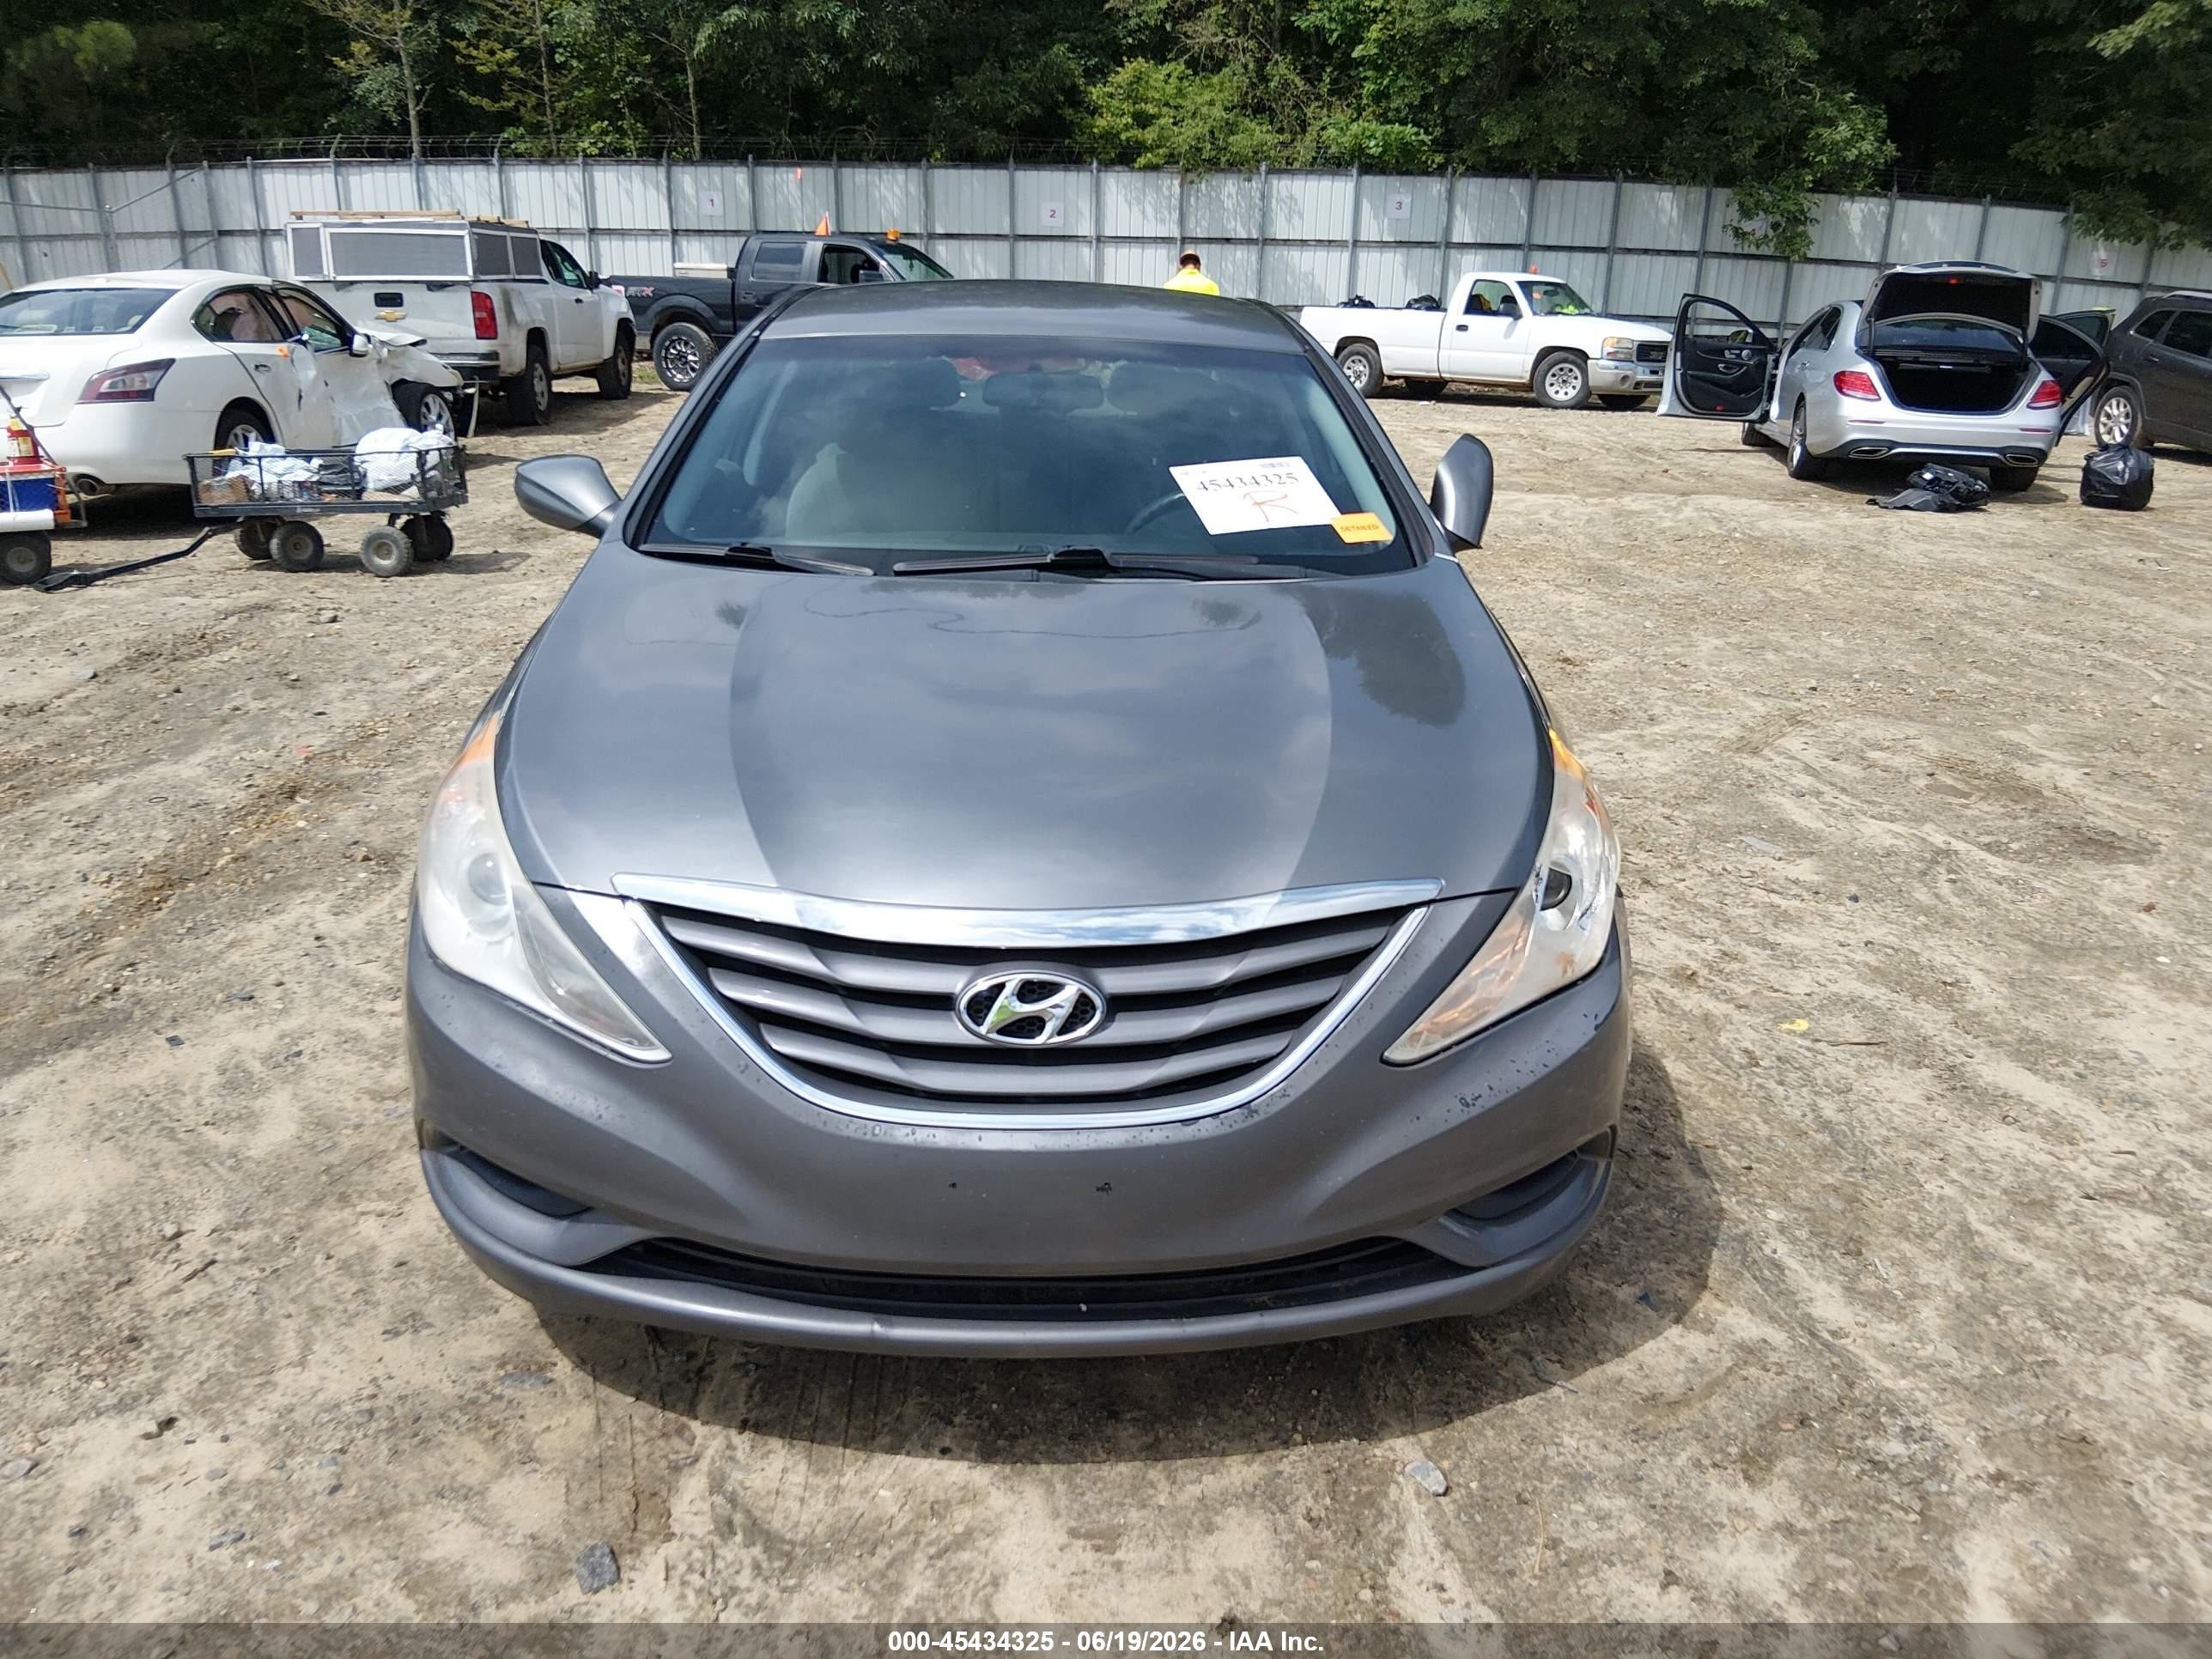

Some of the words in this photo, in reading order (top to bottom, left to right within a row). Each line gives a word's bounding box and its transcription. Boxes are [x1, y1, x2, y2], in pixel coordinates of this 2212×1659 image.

[1395, 201, 1402, 210] 3
[1049, 209, 1056, 218] 2
[1196, 472, 1299, 491] 45434325
